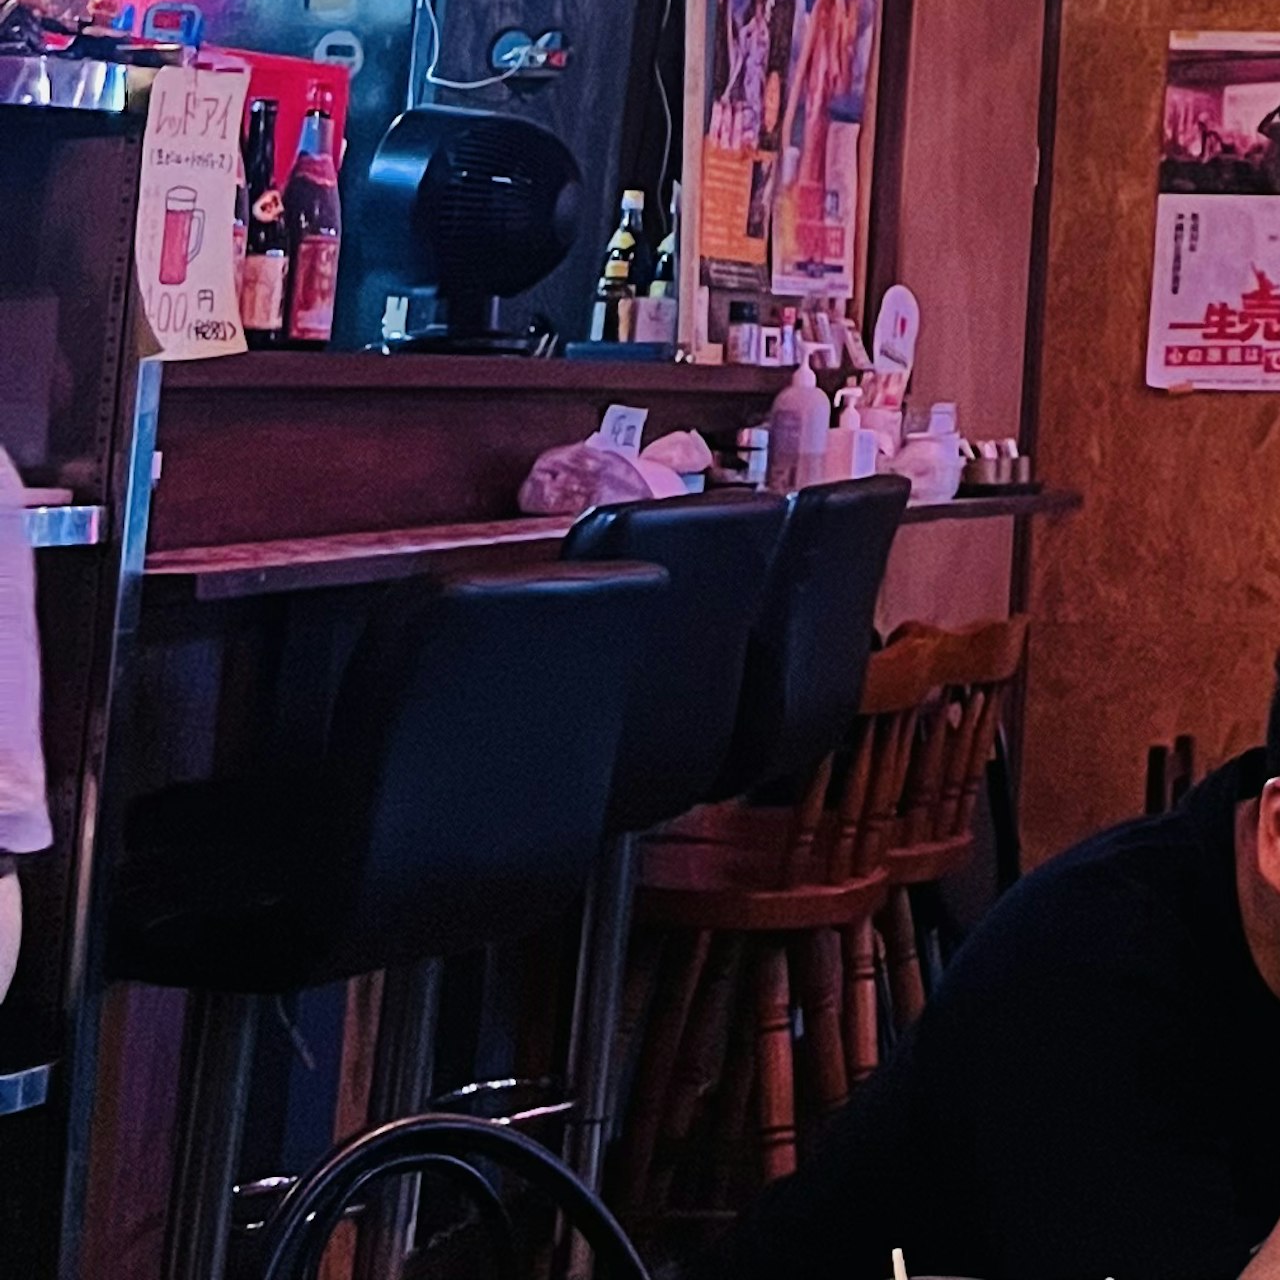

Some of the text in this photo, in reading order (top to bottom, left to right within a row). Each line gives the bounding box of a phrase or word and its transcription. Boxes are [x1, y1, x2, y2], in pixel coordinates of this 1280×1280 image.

[155, 91, 234, 141] レッドアイ
